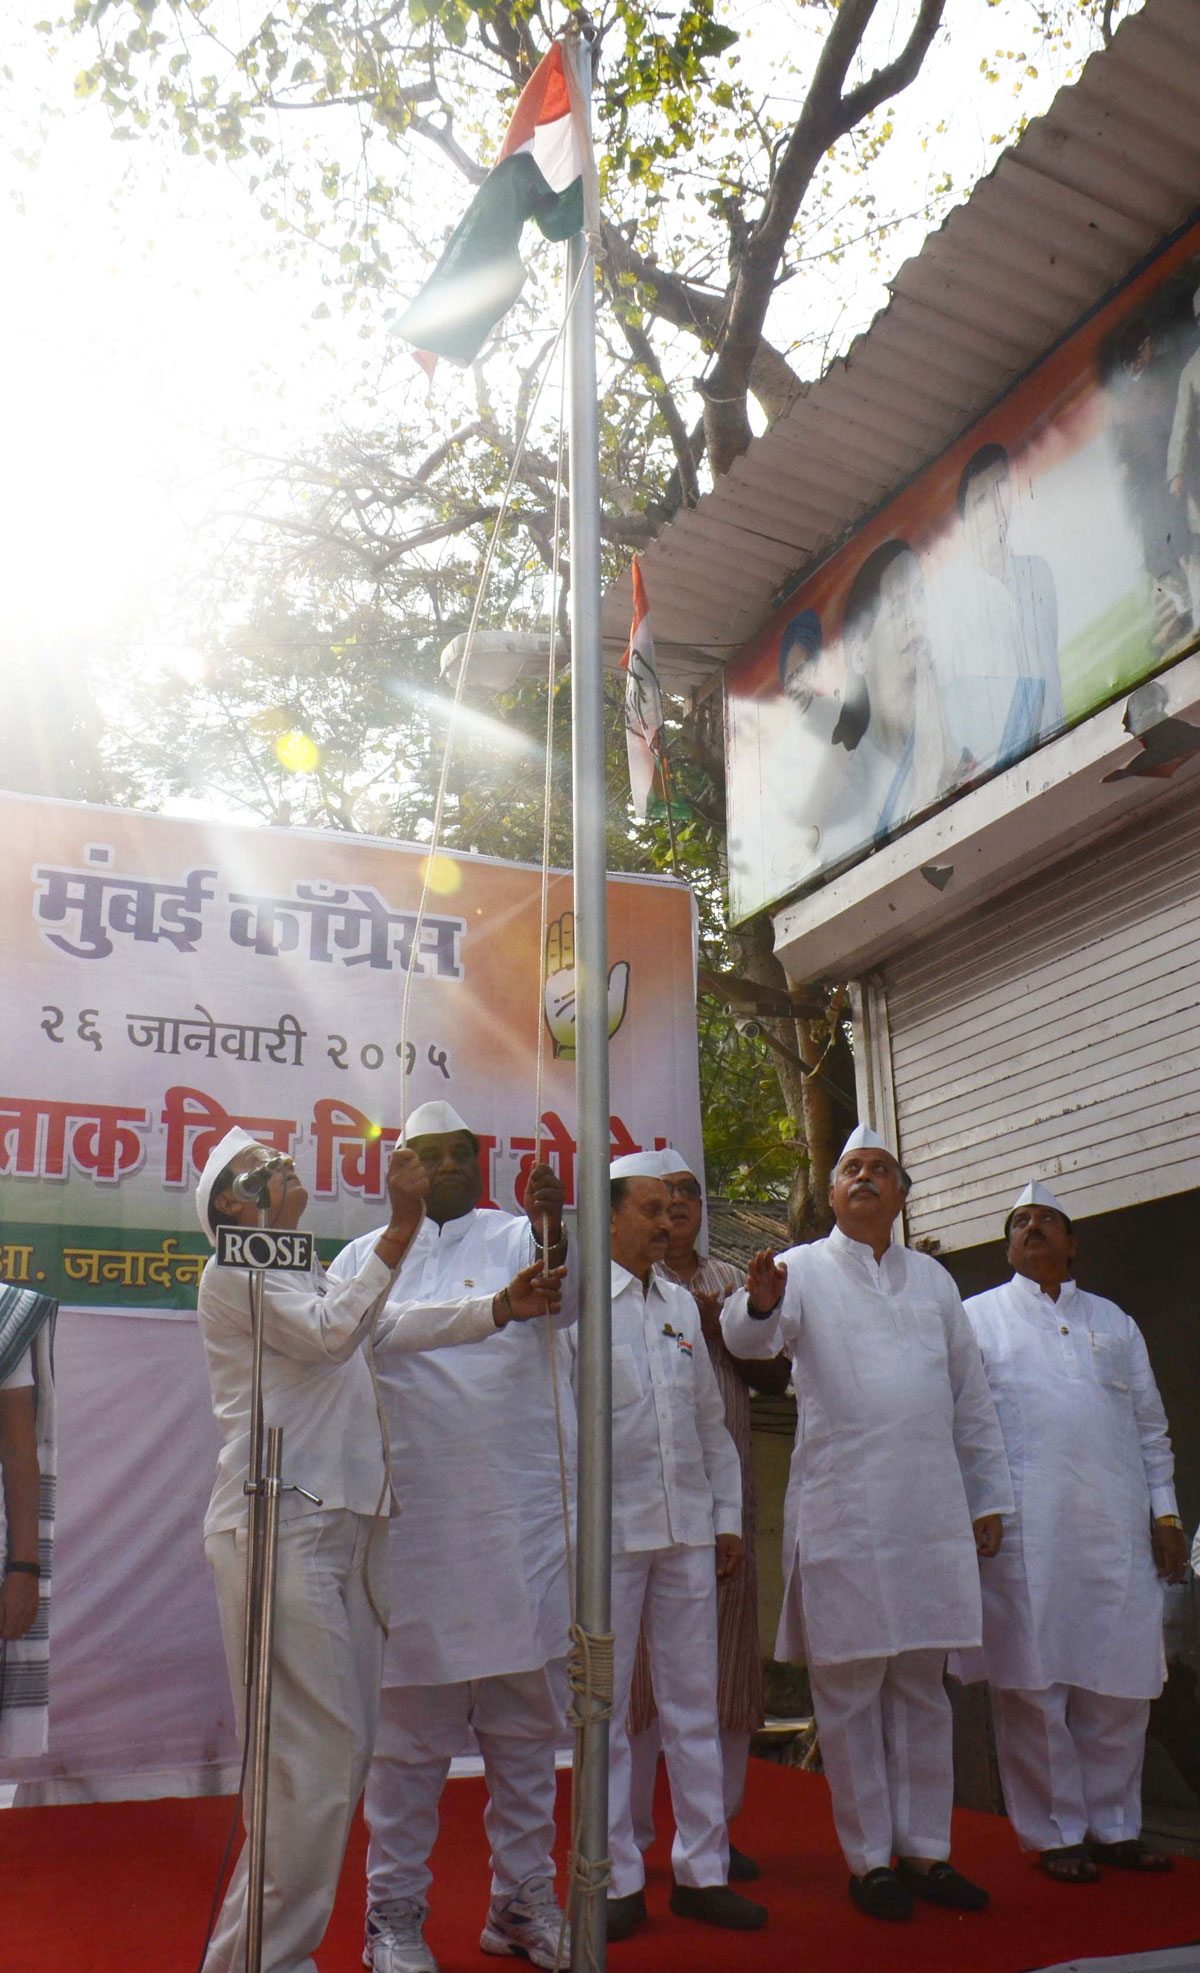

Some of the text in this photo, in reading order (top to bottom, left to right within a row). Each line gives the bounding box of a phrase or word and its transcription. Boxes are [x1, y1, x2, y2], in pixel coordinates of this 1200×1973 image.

[36, 847, 219, 960] मुंबई
[40, 1003, 451, 1080] २६ जानेवारी २०१५
[223, 1232, 308, 1268] ROSE
